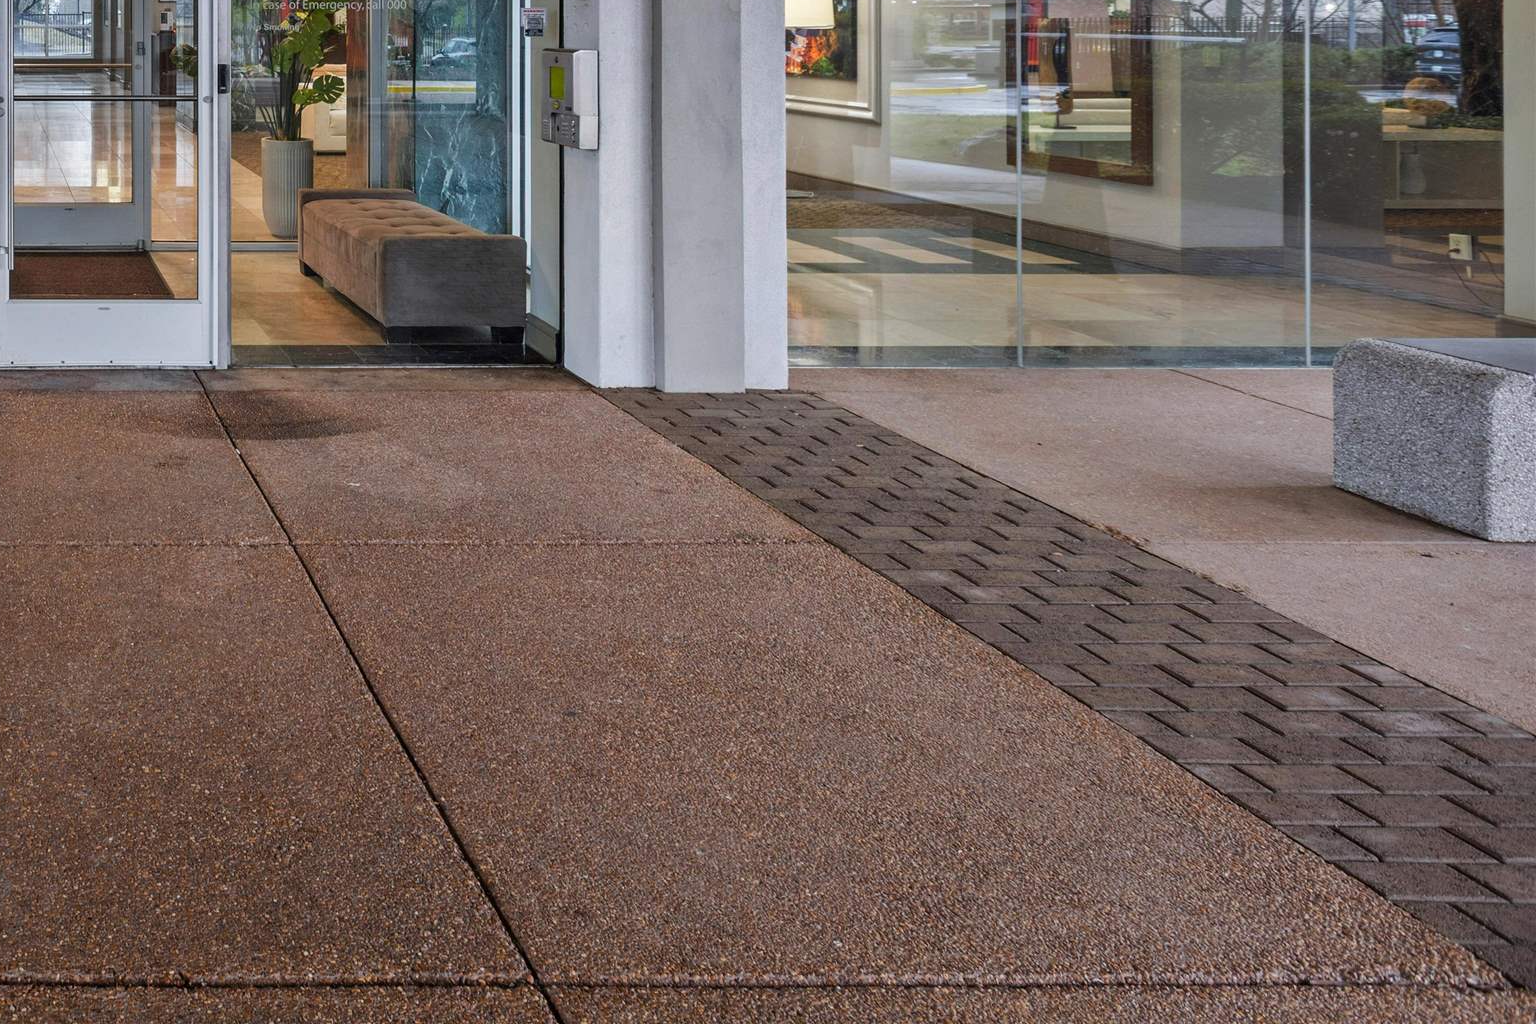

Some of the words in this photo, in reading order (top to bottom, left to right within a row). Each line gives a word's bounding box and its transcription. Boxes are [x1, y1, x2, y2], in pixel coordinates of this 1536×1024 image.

[263, 1, 287, 10] case
[289, 0, 301, 10] of
[302, 0, 365, 12] Emergency,
[387, 0, 407, 10] 000
